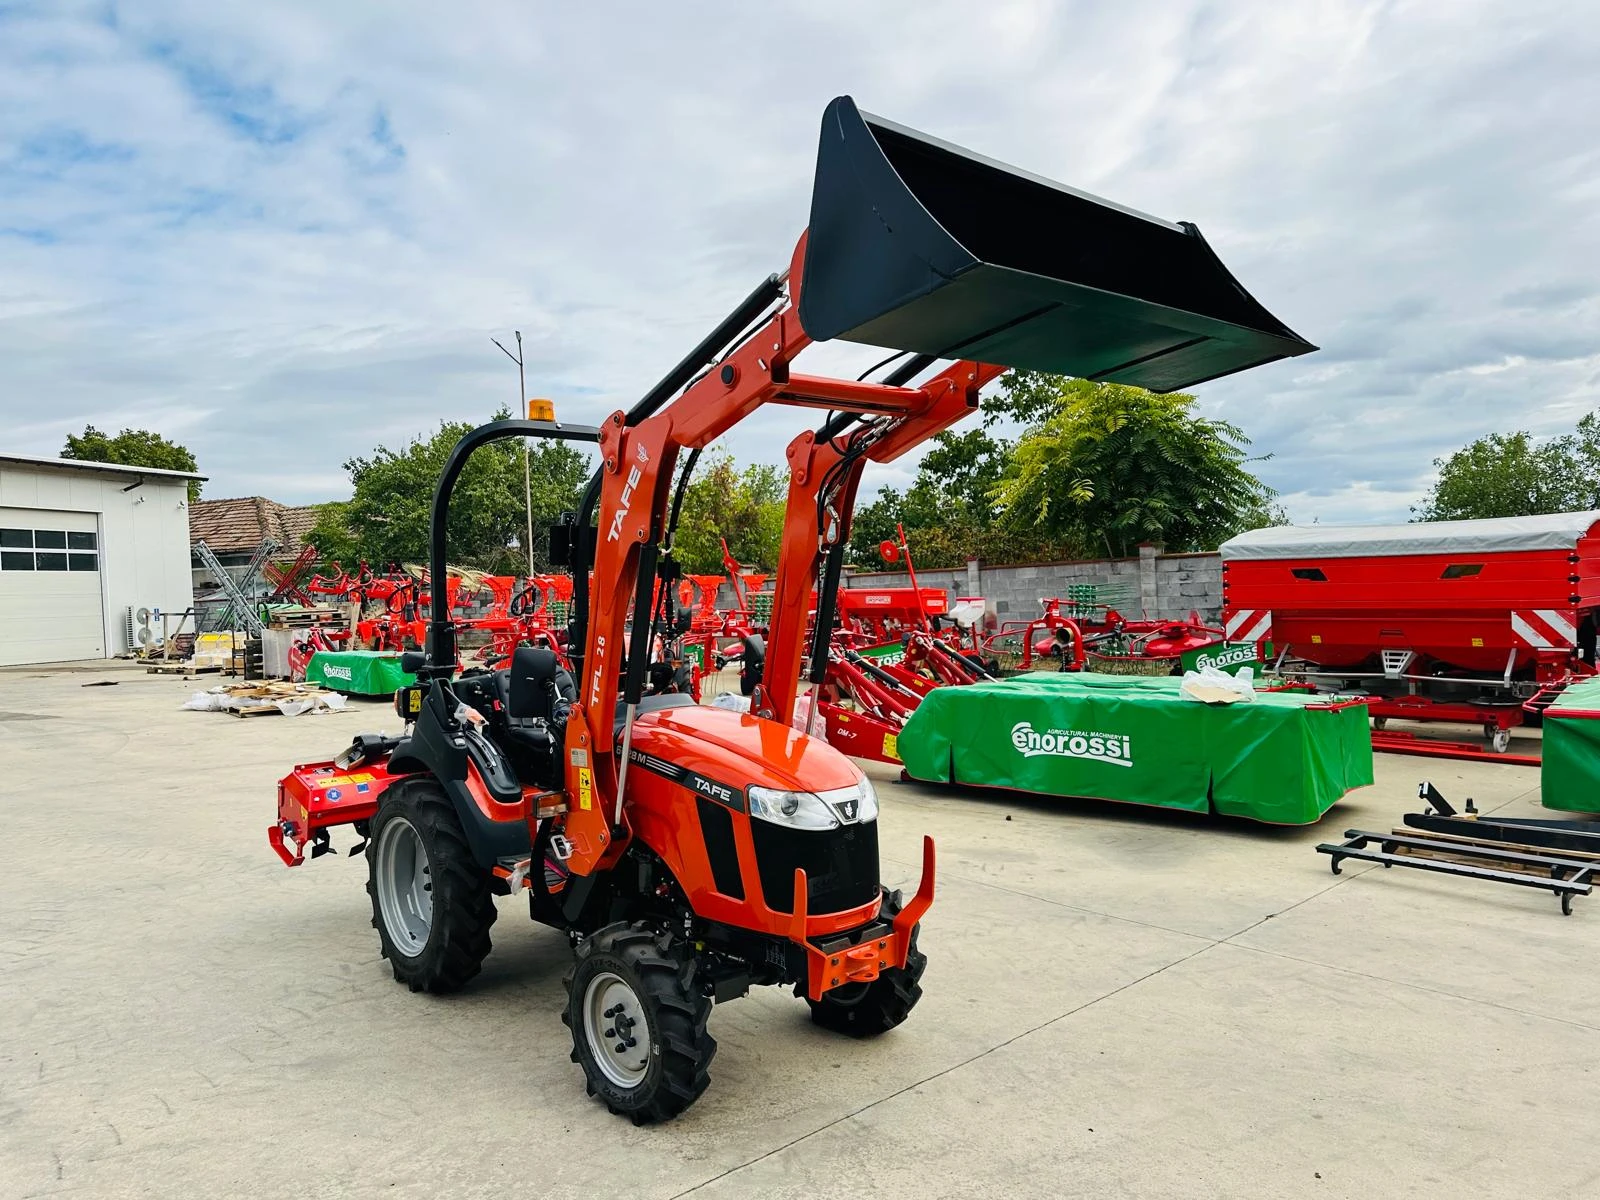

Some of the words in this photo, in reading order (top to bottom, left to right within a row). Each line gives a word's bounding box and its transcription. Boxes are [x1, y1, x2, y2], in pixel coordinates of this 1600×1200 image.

[607, 464, 641, 542] TAFE
[591, 664, 602, 707] TFL
[597, 635, 605, 658] 28
[1196, 644, 1257, 672] enoross
[324, 663, 352, 680] enorossi
[837, 728, 857, 739] DM-7
[1011, 722, 1131, 761] enorossi
[1047, 729, 1088, 737] AGRICULTURAL
[1090, 731, 1122, 740] MACHINERY
[694, 777, 732, 802] TAFE
